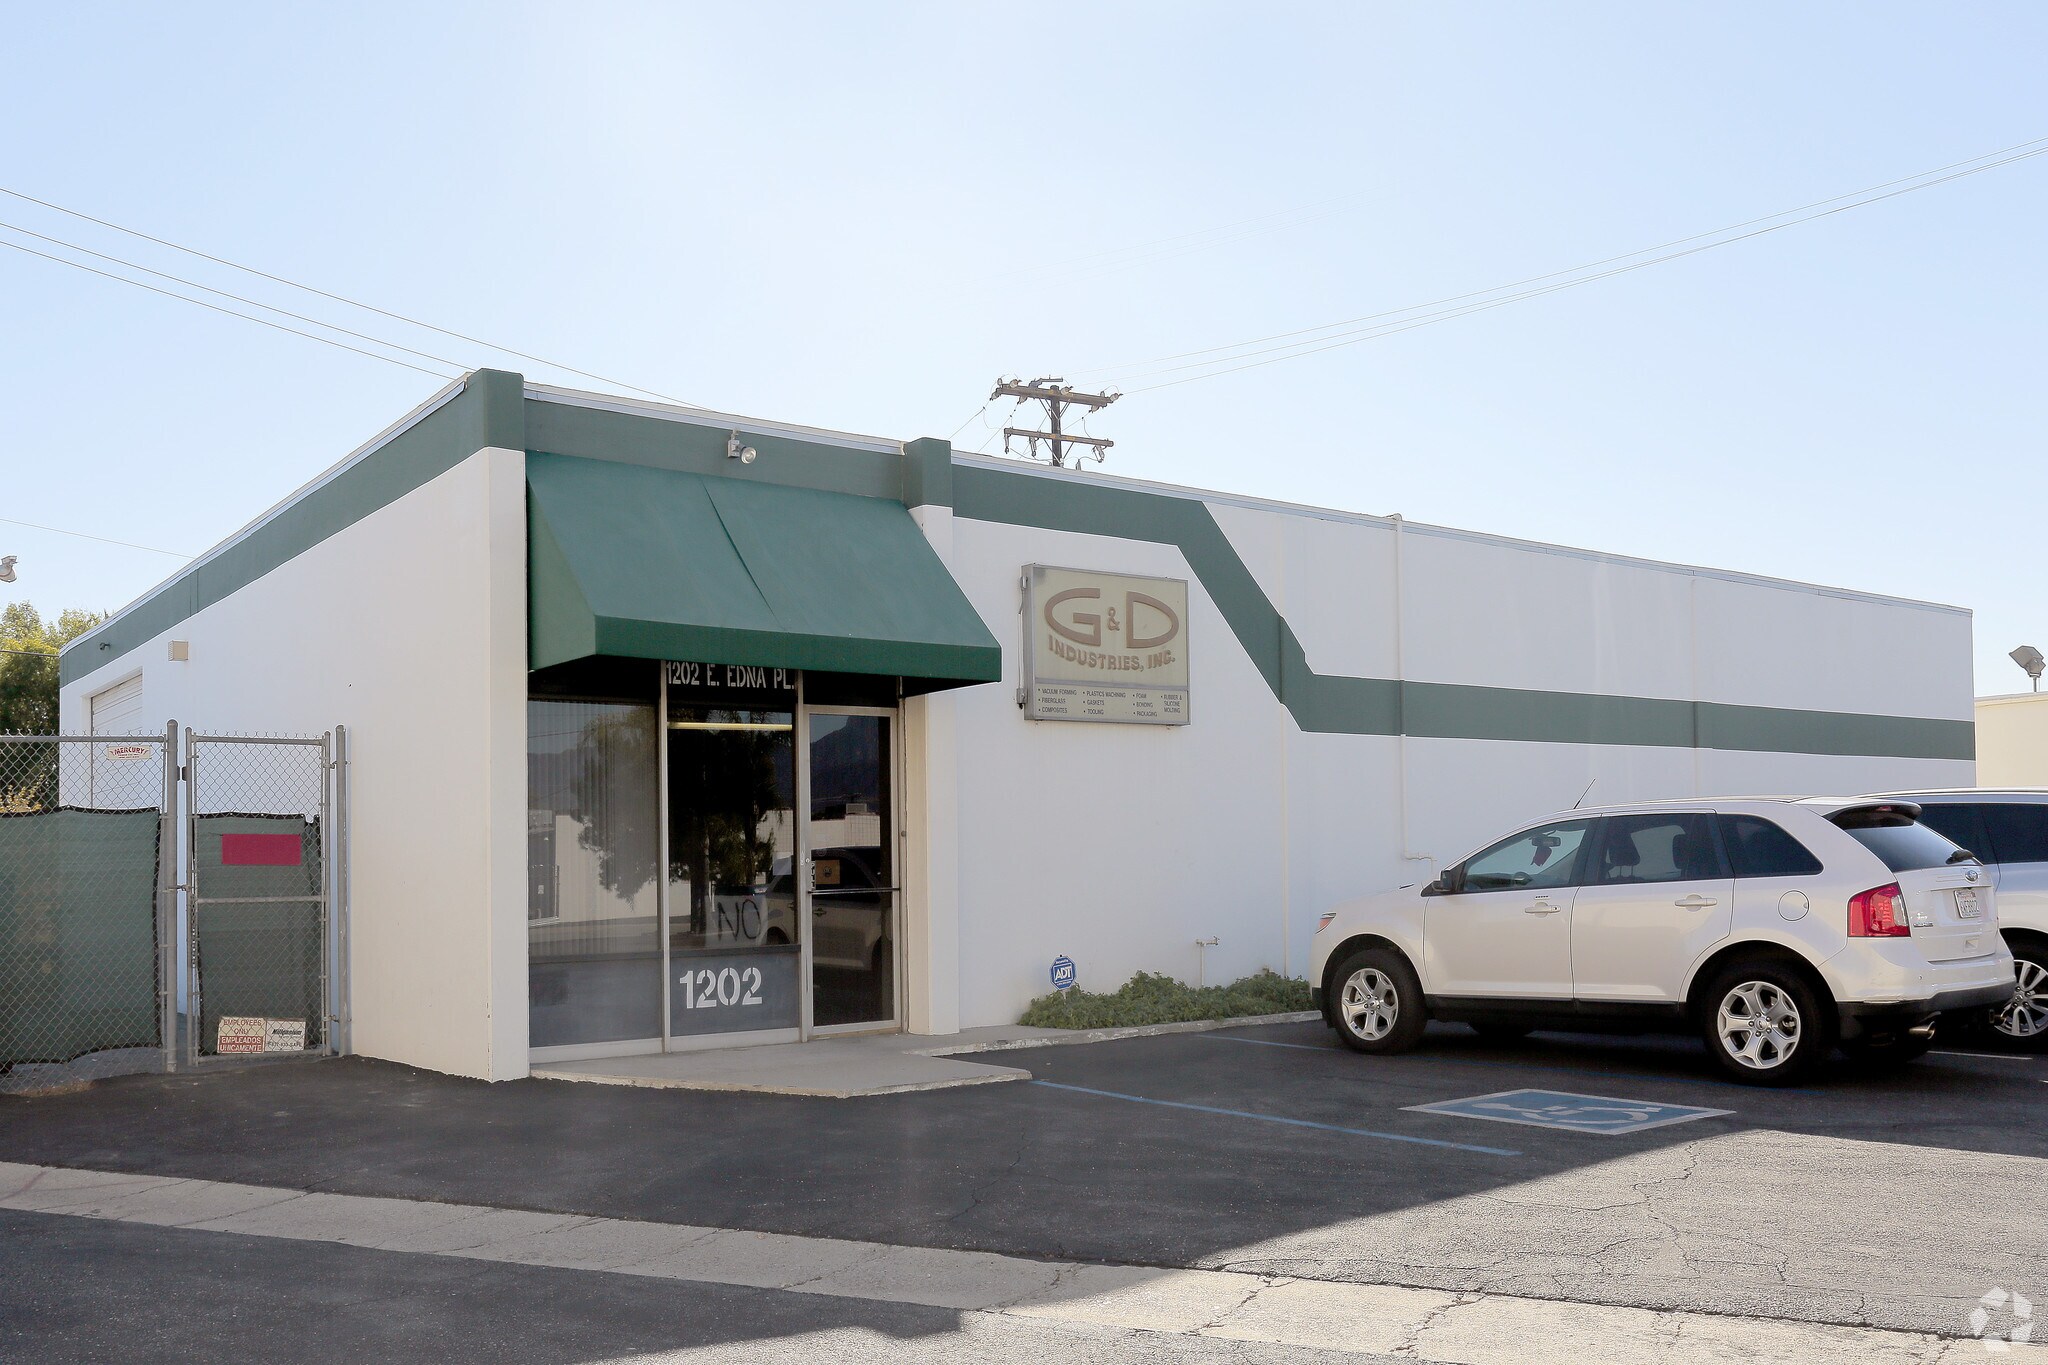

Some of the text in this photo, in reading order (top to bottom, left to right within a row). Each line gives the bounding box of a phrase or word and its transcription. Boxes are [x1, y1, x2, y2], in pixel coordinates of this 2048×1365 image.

[1048, 634, 1176, 672] INDUSTRIES, INC.
[666, 661, 795, 690] 1202 E. EDNA PL.
[1059, 688, 1077, 696] FORMING
[1041, 706, 1068, 714] COMPOSITES
[114, 746, 145, 755] MERCURY
[717, 898, 761, 941] NO
[1055, 967, 1071, 980] ADT
[679, 966, 763, 1009] 1202
[233, 1027, 251, 1035] ONLY
[221, 1036, 262, 1044] EMPLEADOS
